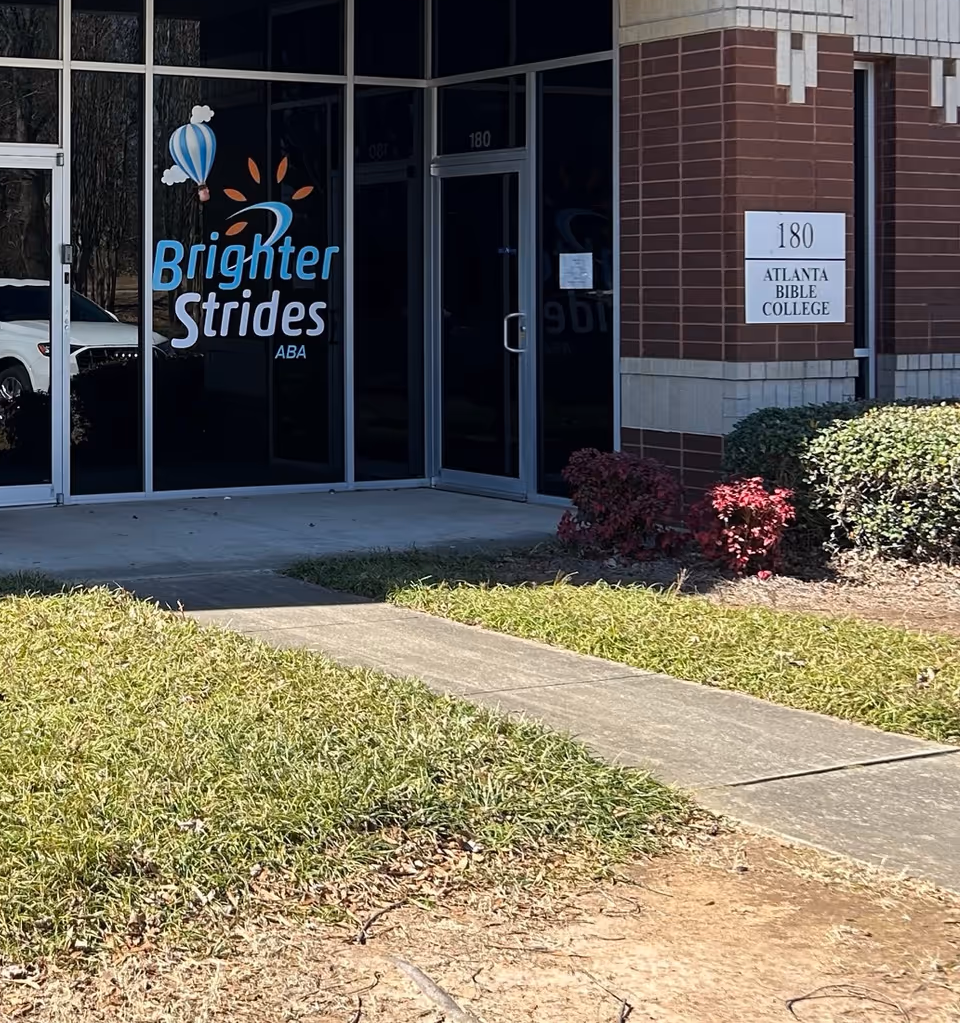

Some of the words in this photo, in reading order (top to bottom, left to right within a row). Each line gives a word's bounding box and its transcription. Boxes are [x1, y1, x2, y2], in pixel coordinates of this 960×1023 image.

[469, 130, 491, 148] 180
[778, 222, 814, 249] 180
[152, 231, 340, 291] Brighter
[763, 267, 829, 282] ATLANTA
[775, 284, 817, 299] BIBLE
[762, 301, 830, 316] COLLEGE
[171, 289, 327, 349] Strides
[275, 345, 307, 359] ABA
